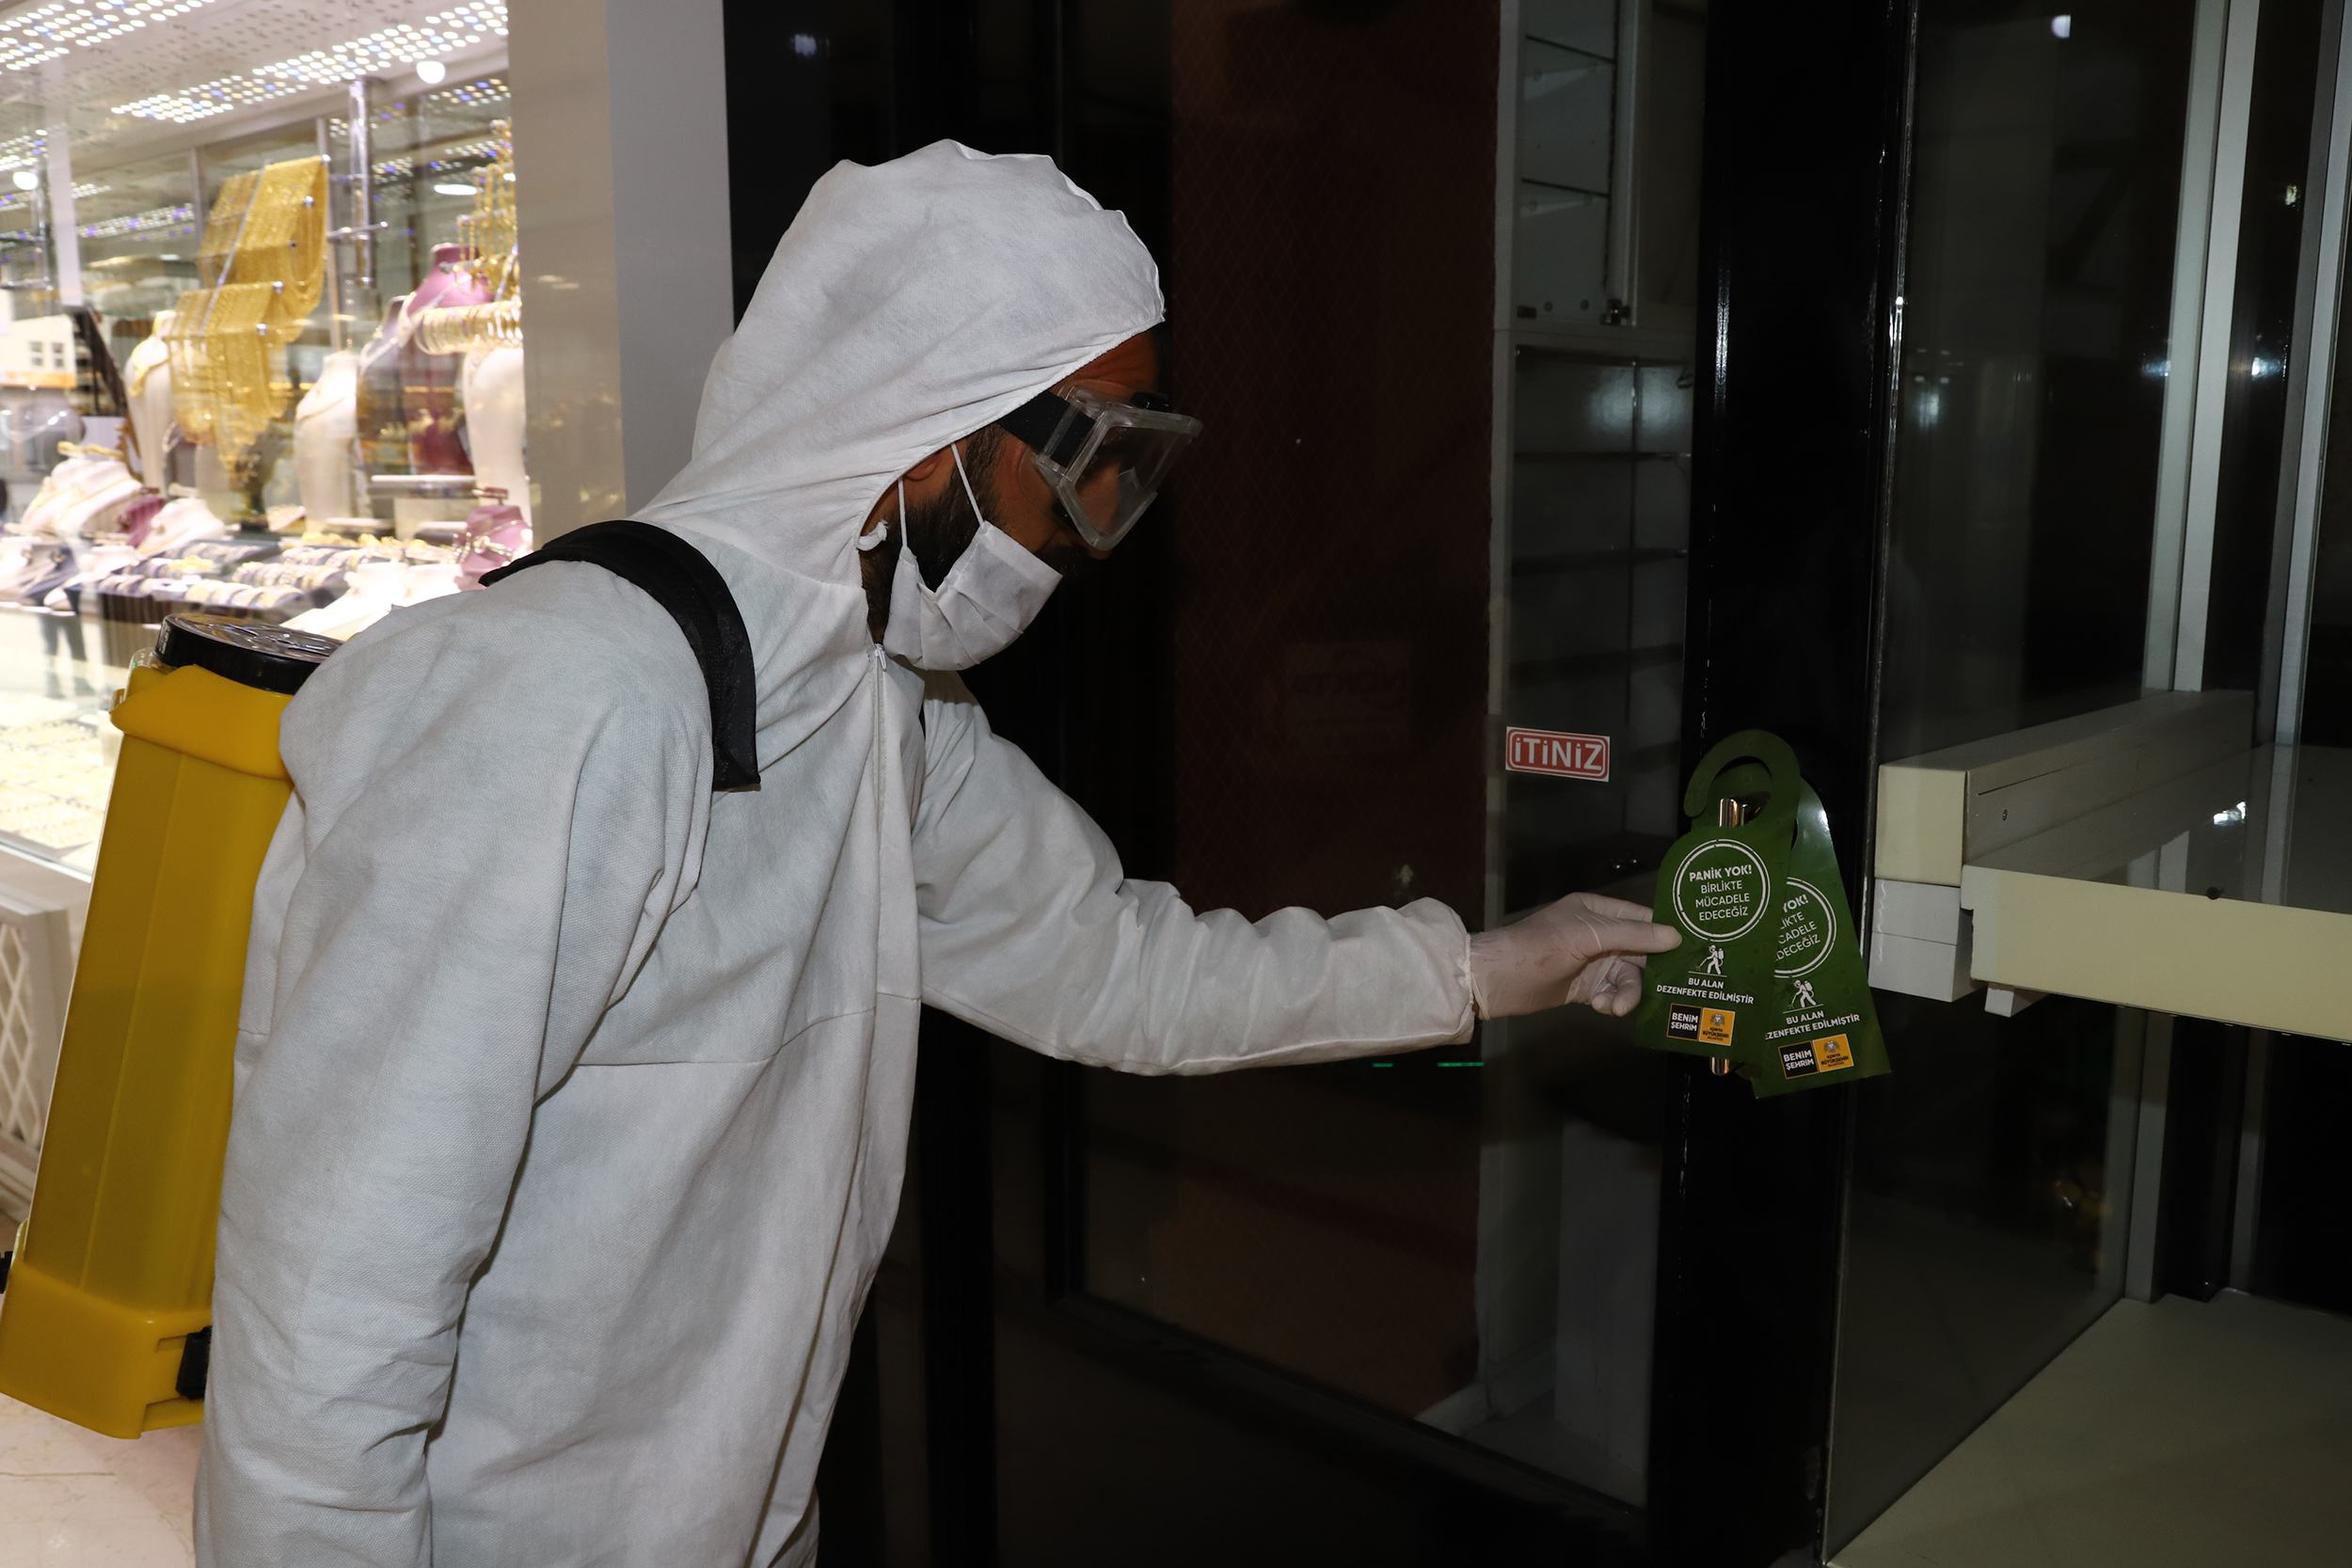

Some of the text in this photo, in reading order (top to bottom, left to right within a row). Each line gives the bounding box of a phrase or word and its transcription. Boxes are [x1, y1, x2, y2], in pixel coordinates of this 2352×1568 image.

[1689, 864, 1753, 882] PANİK YOK!
[1700, 880, 1742, 895] BİRLİKTE
[1695, 893, 1750, 909] MÜCADELE
[1699, 905, 1749, 921] EDECEĞİZ
[1780, 911, 1804, 930] İKTE
[1777, 921, 1818, 944] CADELE
[1776, 934, 1820, 960] DECEĞİZ
[1688, 977, 1724, 990] BU ALAN
[1657, 985, 1755, 1005] DEZENFEKTE EDİLMİŞTİR
[1786, 1010, 1824, 1025] BU ALAN
[1765, 1014, 1861, 1040] ZENFEKTE EDİLMİŞTİR
